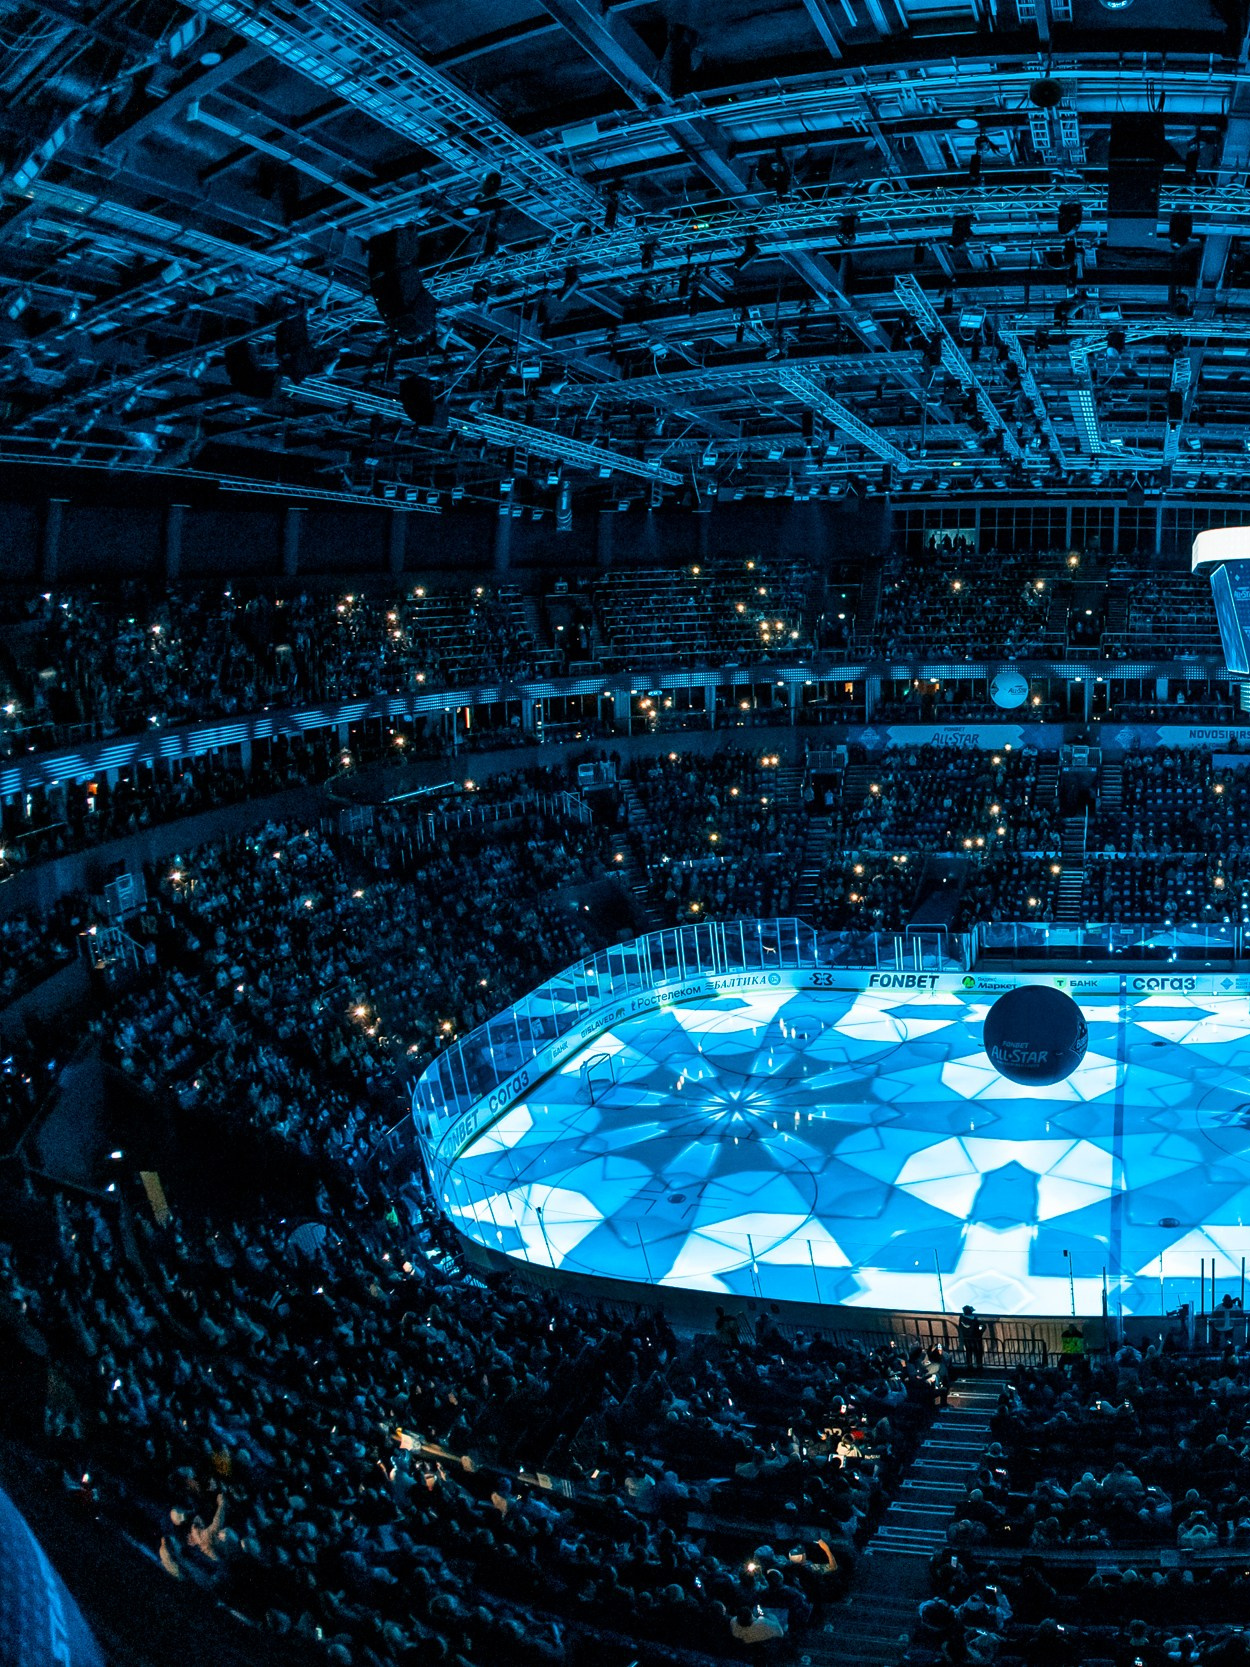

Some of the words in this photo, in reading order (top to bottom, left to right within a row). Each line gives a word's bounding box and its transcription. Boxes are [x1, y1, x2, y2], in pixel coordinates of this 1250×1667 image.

[714, 976, 766, 989] БАЛТИКА
[869, 974, 940, 988] FONBET
[978, 982, 1017, 990] Маркет
[637, 986, 701, 1009] Ростелеком
[581, 1013, 614, 1038] GISLAVED
[553, 1041, 568, 1058] БАНК
